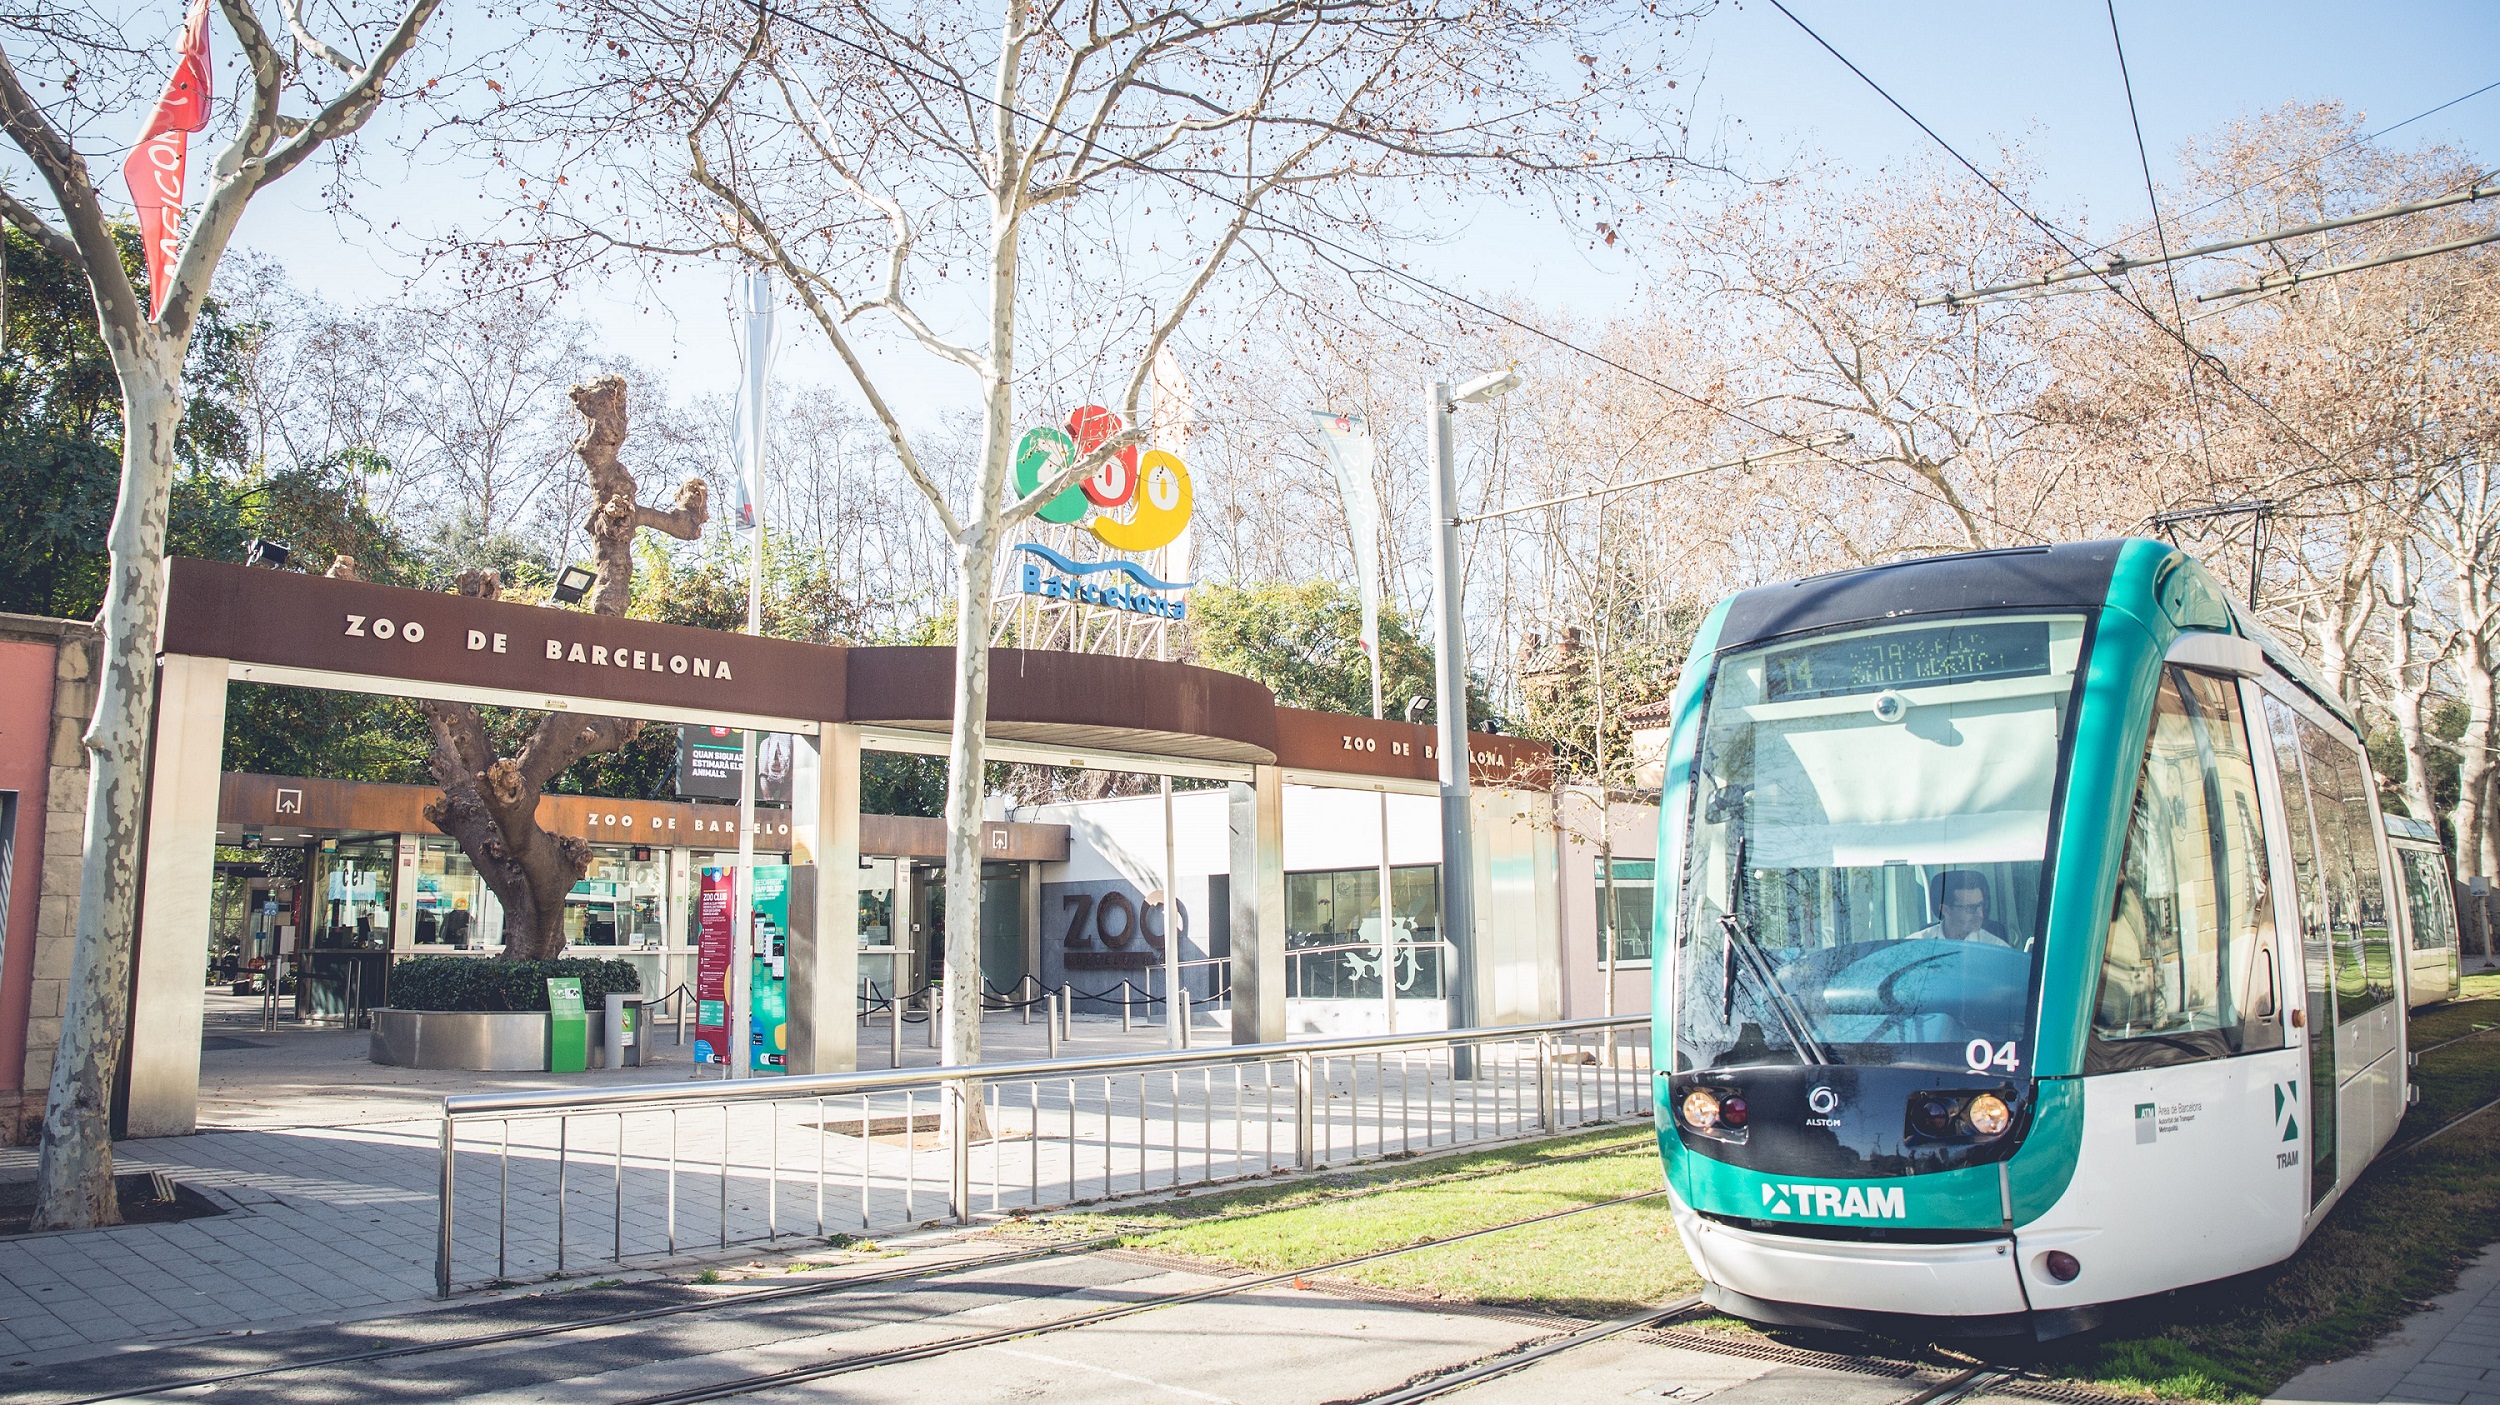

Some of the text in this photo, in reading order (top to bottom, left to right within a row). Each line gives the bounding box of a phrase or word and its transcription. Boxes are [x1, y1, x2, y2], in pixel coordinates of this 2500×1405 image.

[1022, 563, 1186, 619] Barcelona
[344, 614, 732, 680] ZOO DE BARCELONA
[692, 750, 714, 760] QUAN
[714, 752, 734, 761] SIGUI
[1342, 735, 1505, 767] ZOO DE BLONA
[691, 768, 727, 778] ANIMALS.
[730, 763, 744, 771] ELS
[588, 813, 789, 836] ZOO DE BARELO
[703, 892, 728, 901] ZOO CLUB
[1063, 889, 1178, 949] ZOO
[1965, 1038, 2020, 1072] 04
[2141, 1107, 2155, 1119] ATM
[2170, 1106, 2178, 1115] de
[2178, 1102, 2202, 1113] Barcelona
[1806, 1118, 1841, 1127] ALSTOM
[2179, 1114, 2195, 1122] Transport
[2276, 1150, 2299, 1170] TRAM
[1790, 1184, 1906, 1219] TRAM
